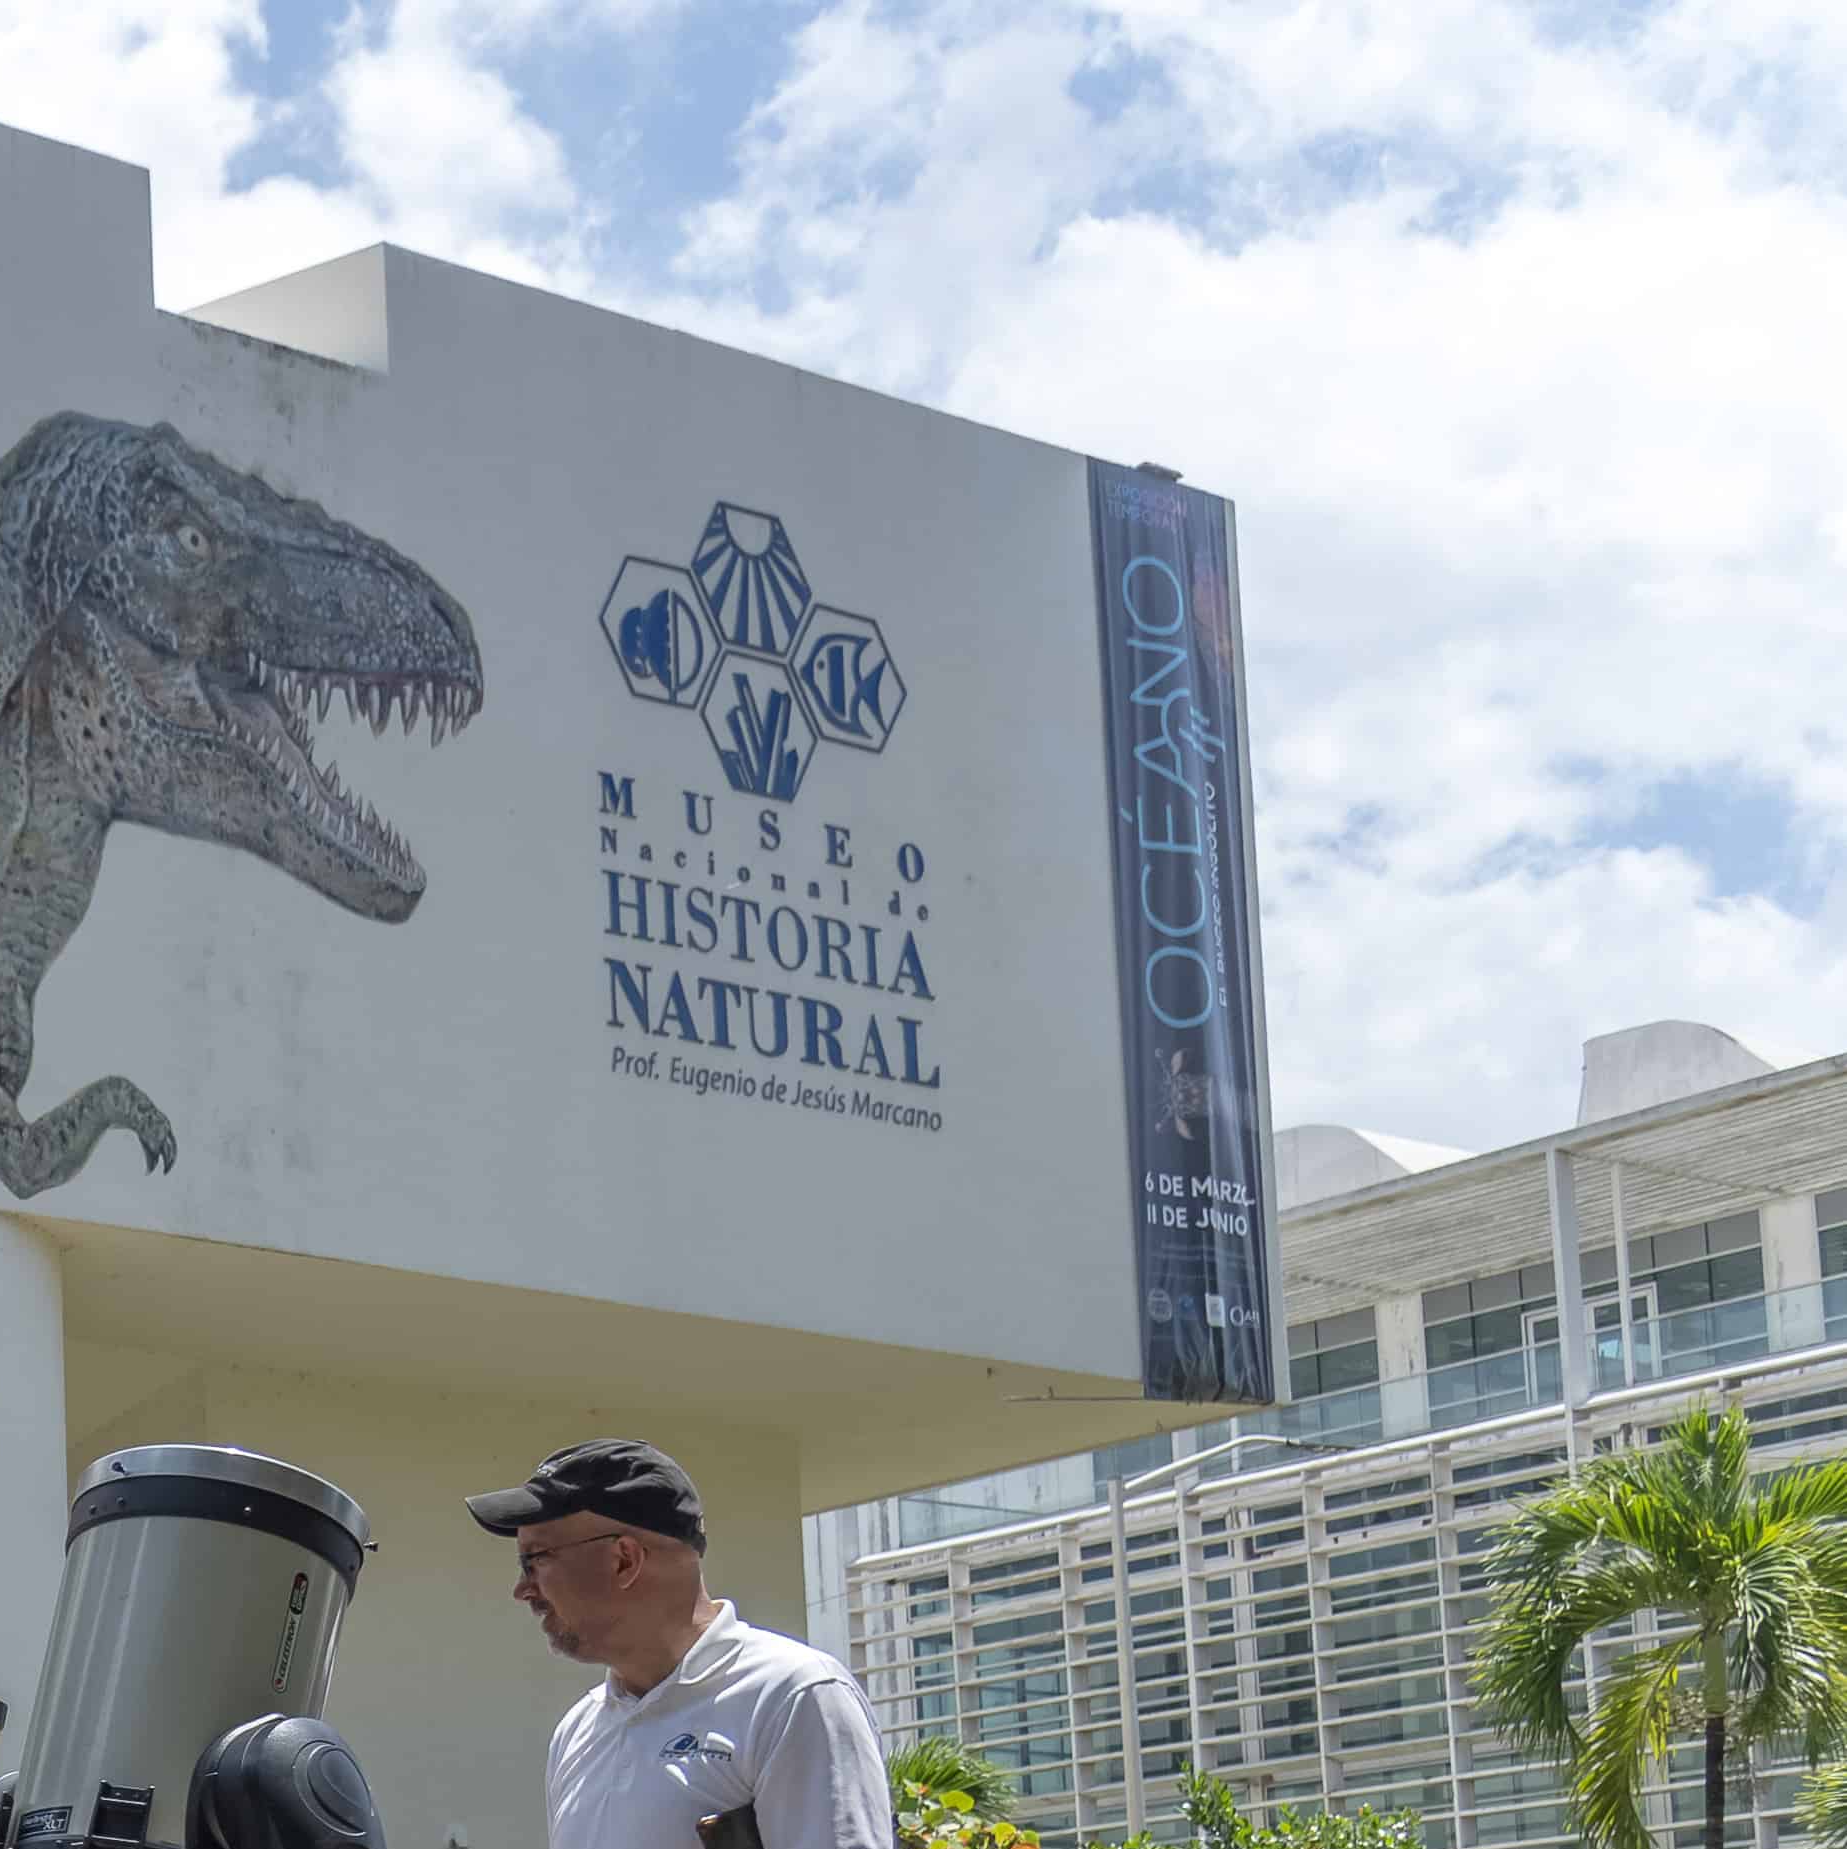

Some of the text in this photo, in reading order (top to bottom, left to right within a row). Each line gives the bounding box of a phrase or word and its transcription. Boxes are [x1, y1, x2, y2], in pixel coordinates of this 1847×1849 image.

[597, 770, 925, 883] MUSEO
[1120, 556, 1213, 1029] OCÉANO
[599, 825, 929, 921] Nacional de
[601, 868, 937, 1002] HISTORIA
[603, 956, 941, 1090] NATURAL
[610, 1045, 944, 1133] Prof. Eugenio de Jesús Marcano
[1144, 1170, 1155, 1193] 6
[1158, 1173, 1184, 1198] DE
[1162, 1204, 1189, 1229] DE
